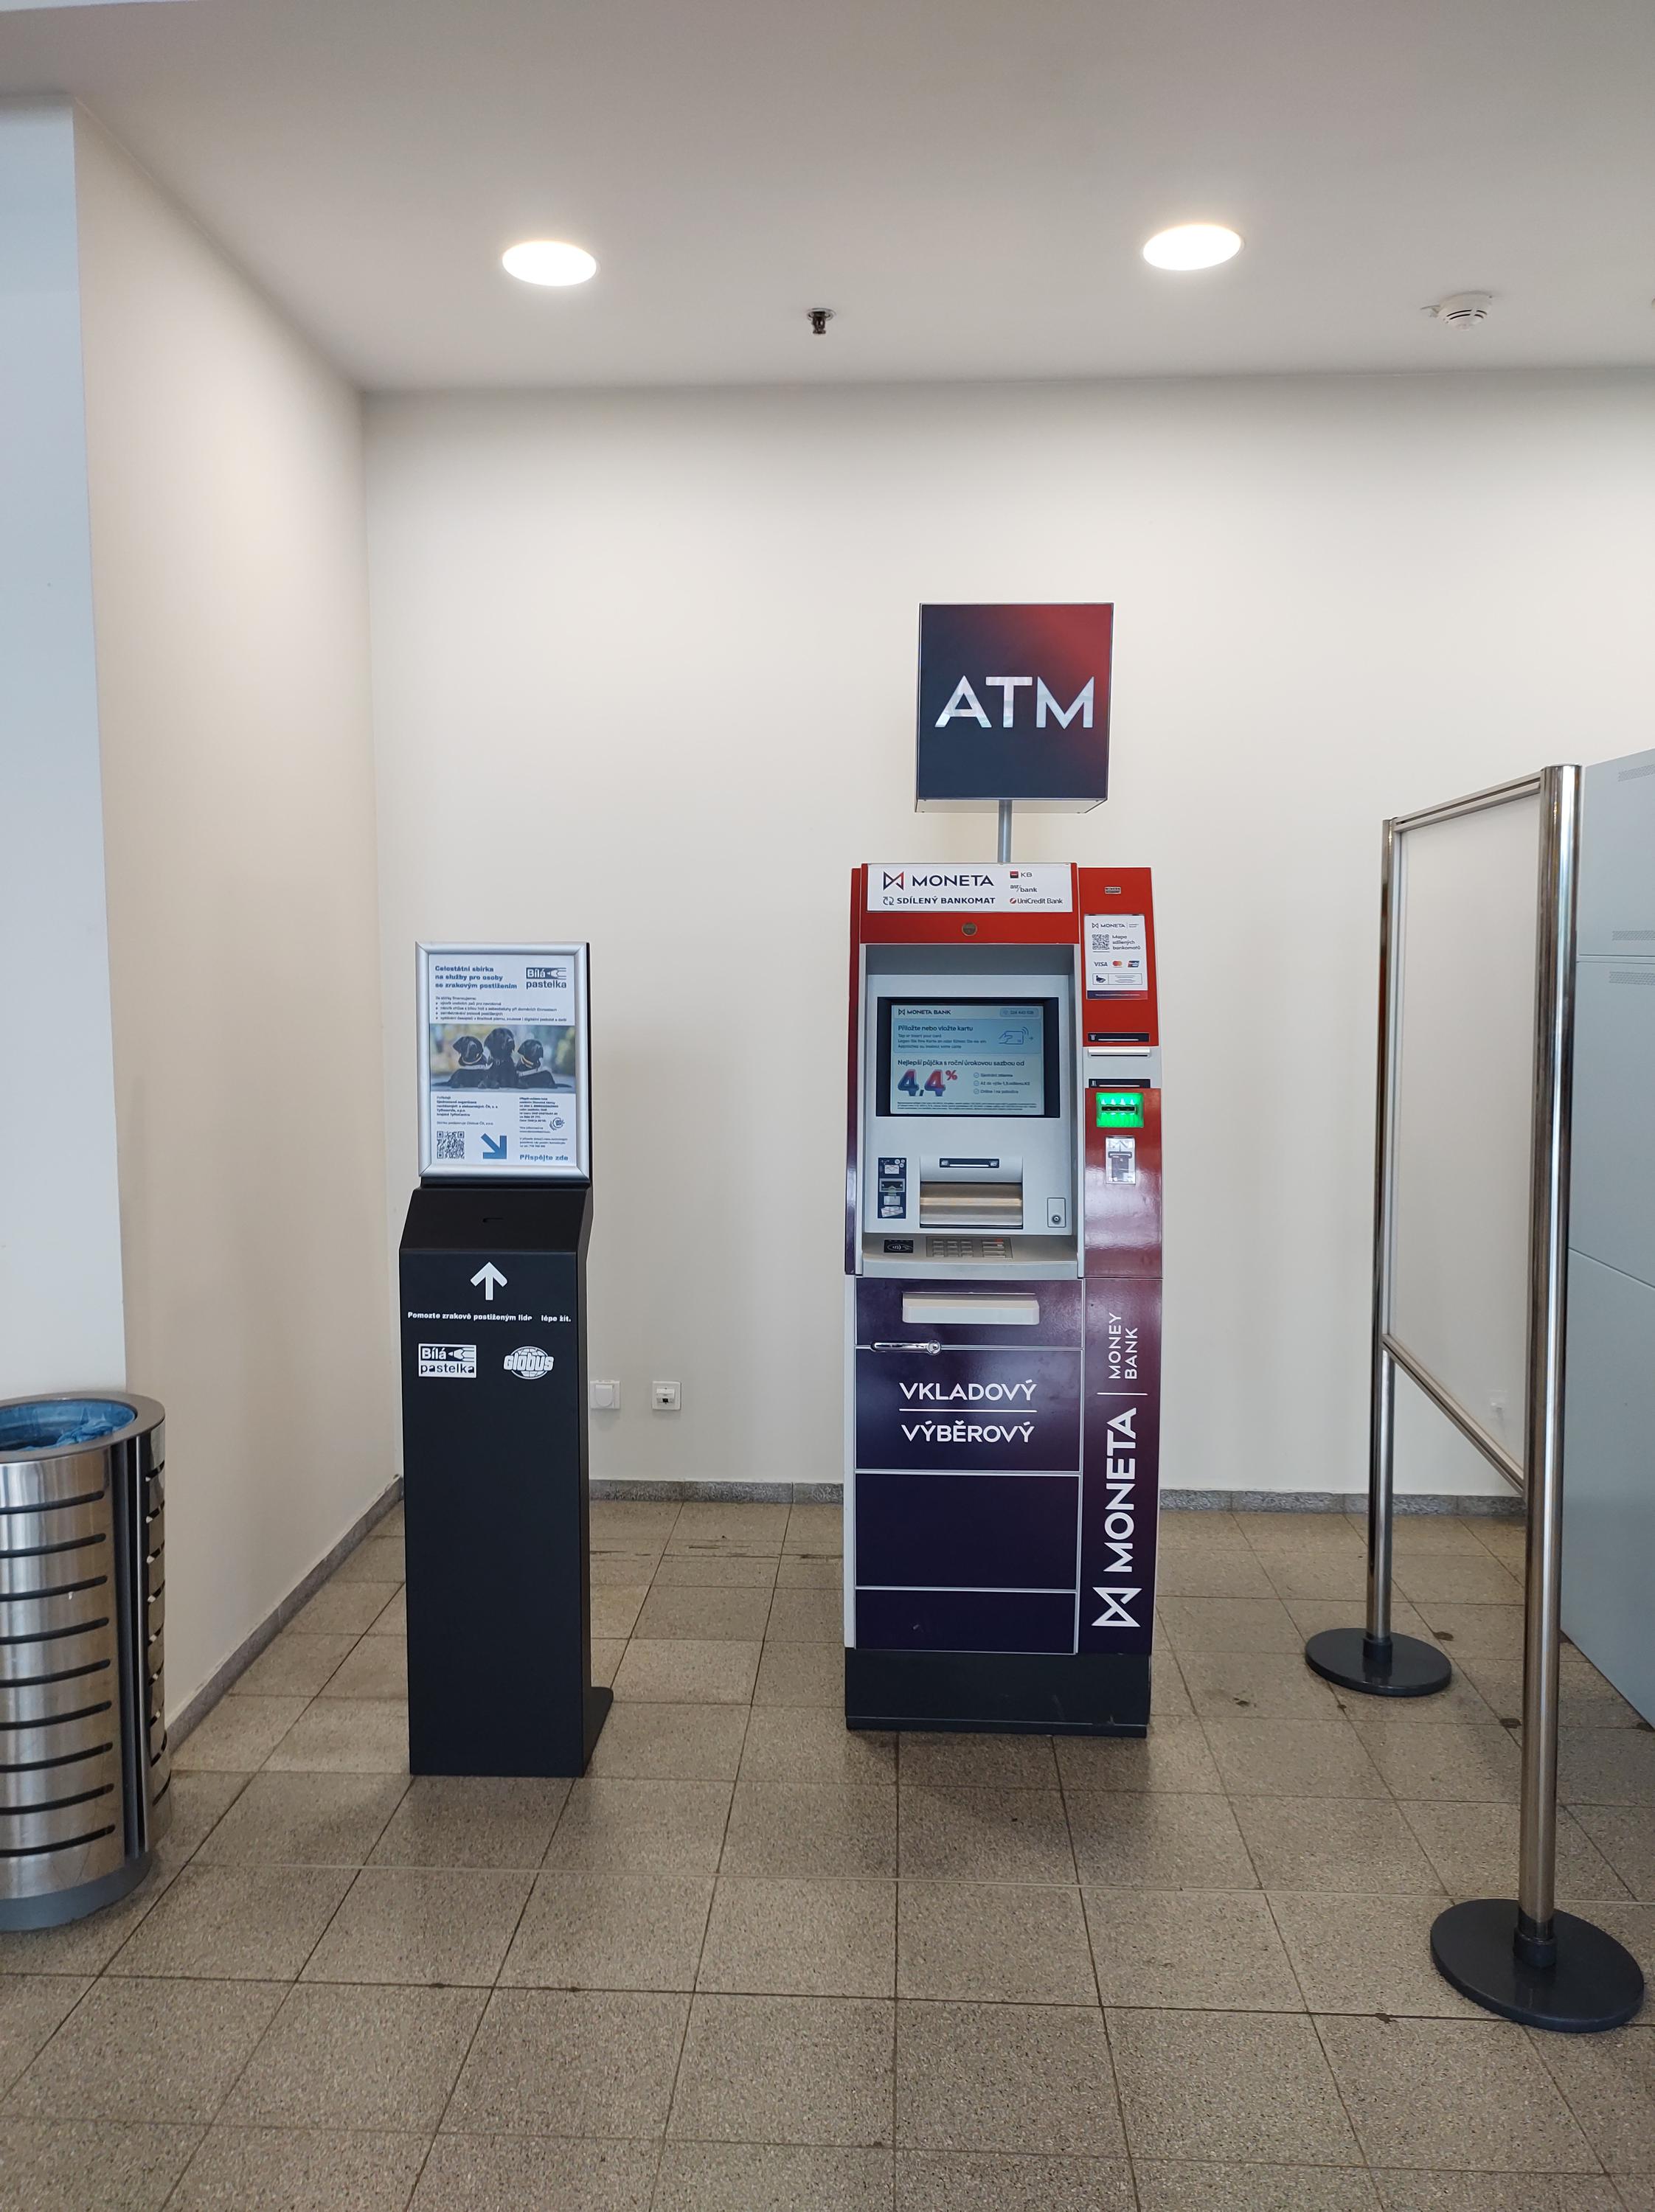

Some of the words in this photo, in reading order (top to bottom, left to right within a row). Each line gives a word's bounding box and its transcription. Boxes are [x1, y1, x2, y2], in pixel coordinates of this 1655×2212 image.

[934, 675, 1094, 729] ATM
[912, 874, 994, 886] MONETA
[897, 895, 938, 905] SDÍLENÝ
[941, 897, 996, 905] BANKOMAT
[527, 968, 546, 978] Bílá
[526, 980, 567, 990] pastelka
[473, 1313, 516, 1321] postiženým
[541, 1315, 558, 1323] lépe
[1108, 1312, 1123, 1380] MONEY
[422, 1347, 447, 1360] Bílá
[1124, 1327, 1139, 1380] BANK
[420, 1363, 475, 1374] pastelka
[899, 1379, 1038, 1401] VKLADOVÝ
[901, 1420, 1035, 1443] VÝBĚROVÝ
[1103, 1407, 1137, 1573] MONETA
